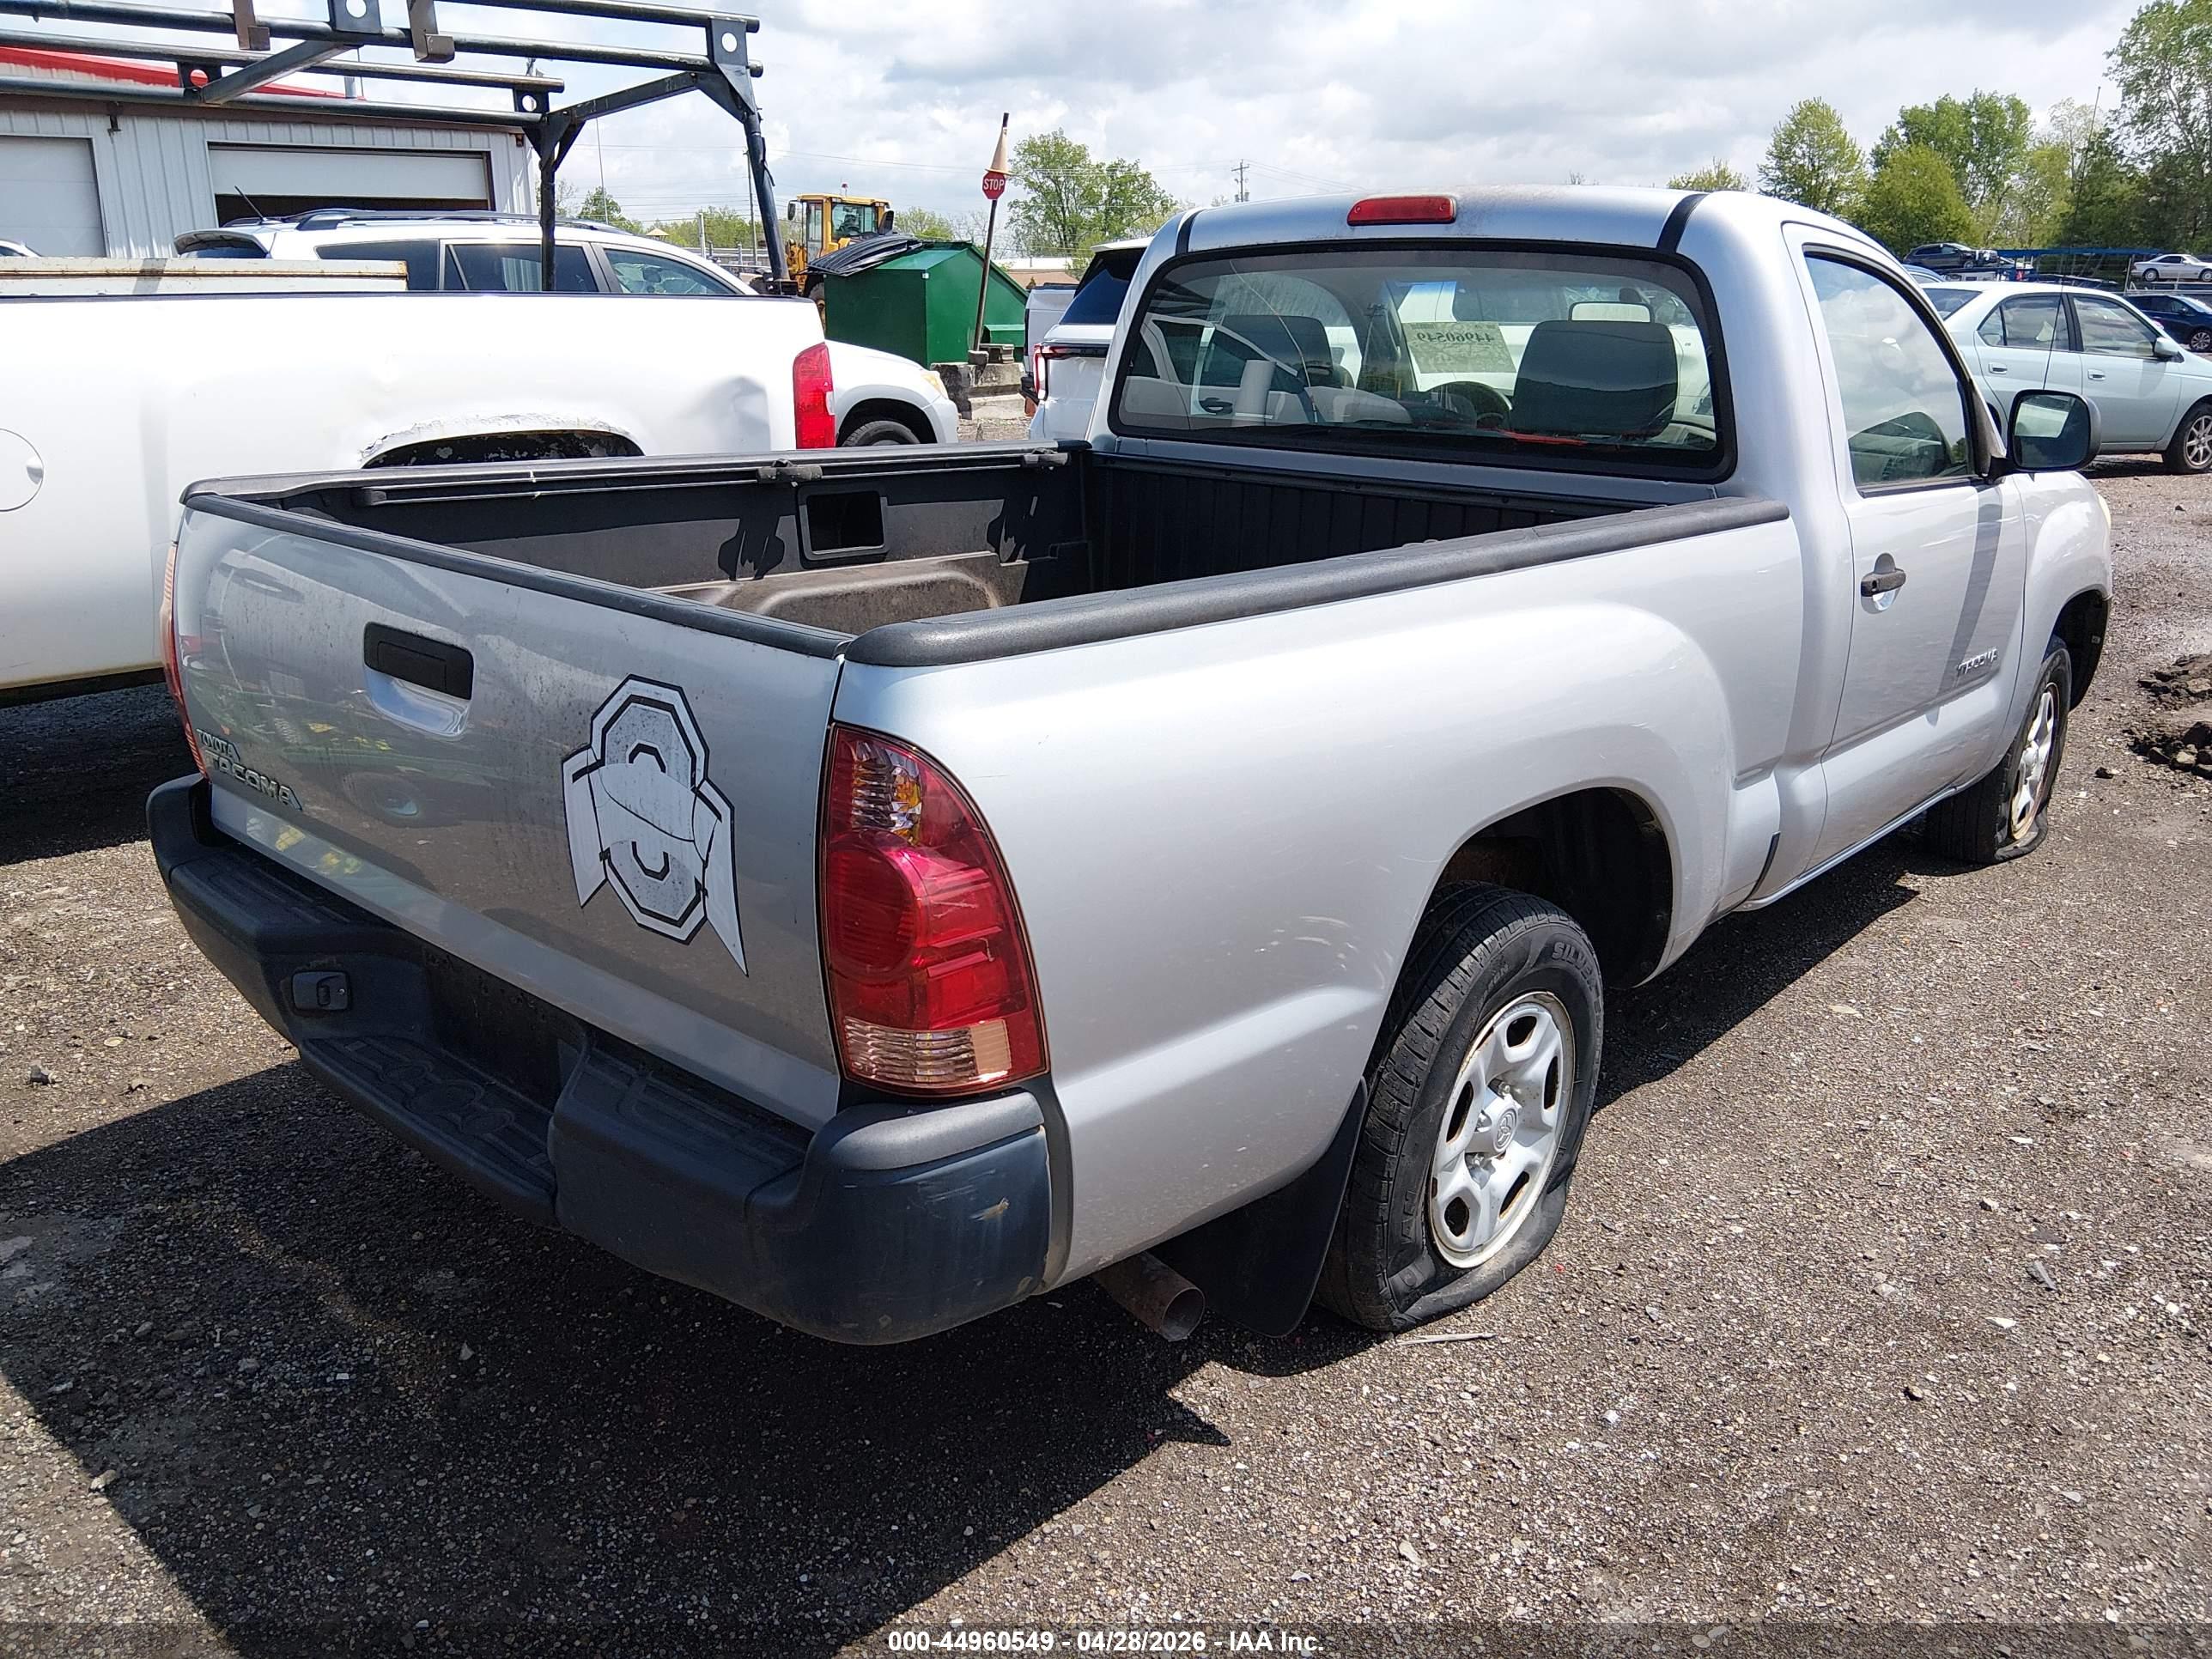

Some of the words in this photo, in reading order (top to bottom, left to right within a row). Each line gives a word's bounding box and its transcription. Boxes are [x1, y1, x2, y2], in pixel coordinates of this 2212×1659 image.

[983, 178, 1005, 191] STOP
[196, 728, 240, 762] TOYOTA
[205, 749, 302, 811] TACOMA
